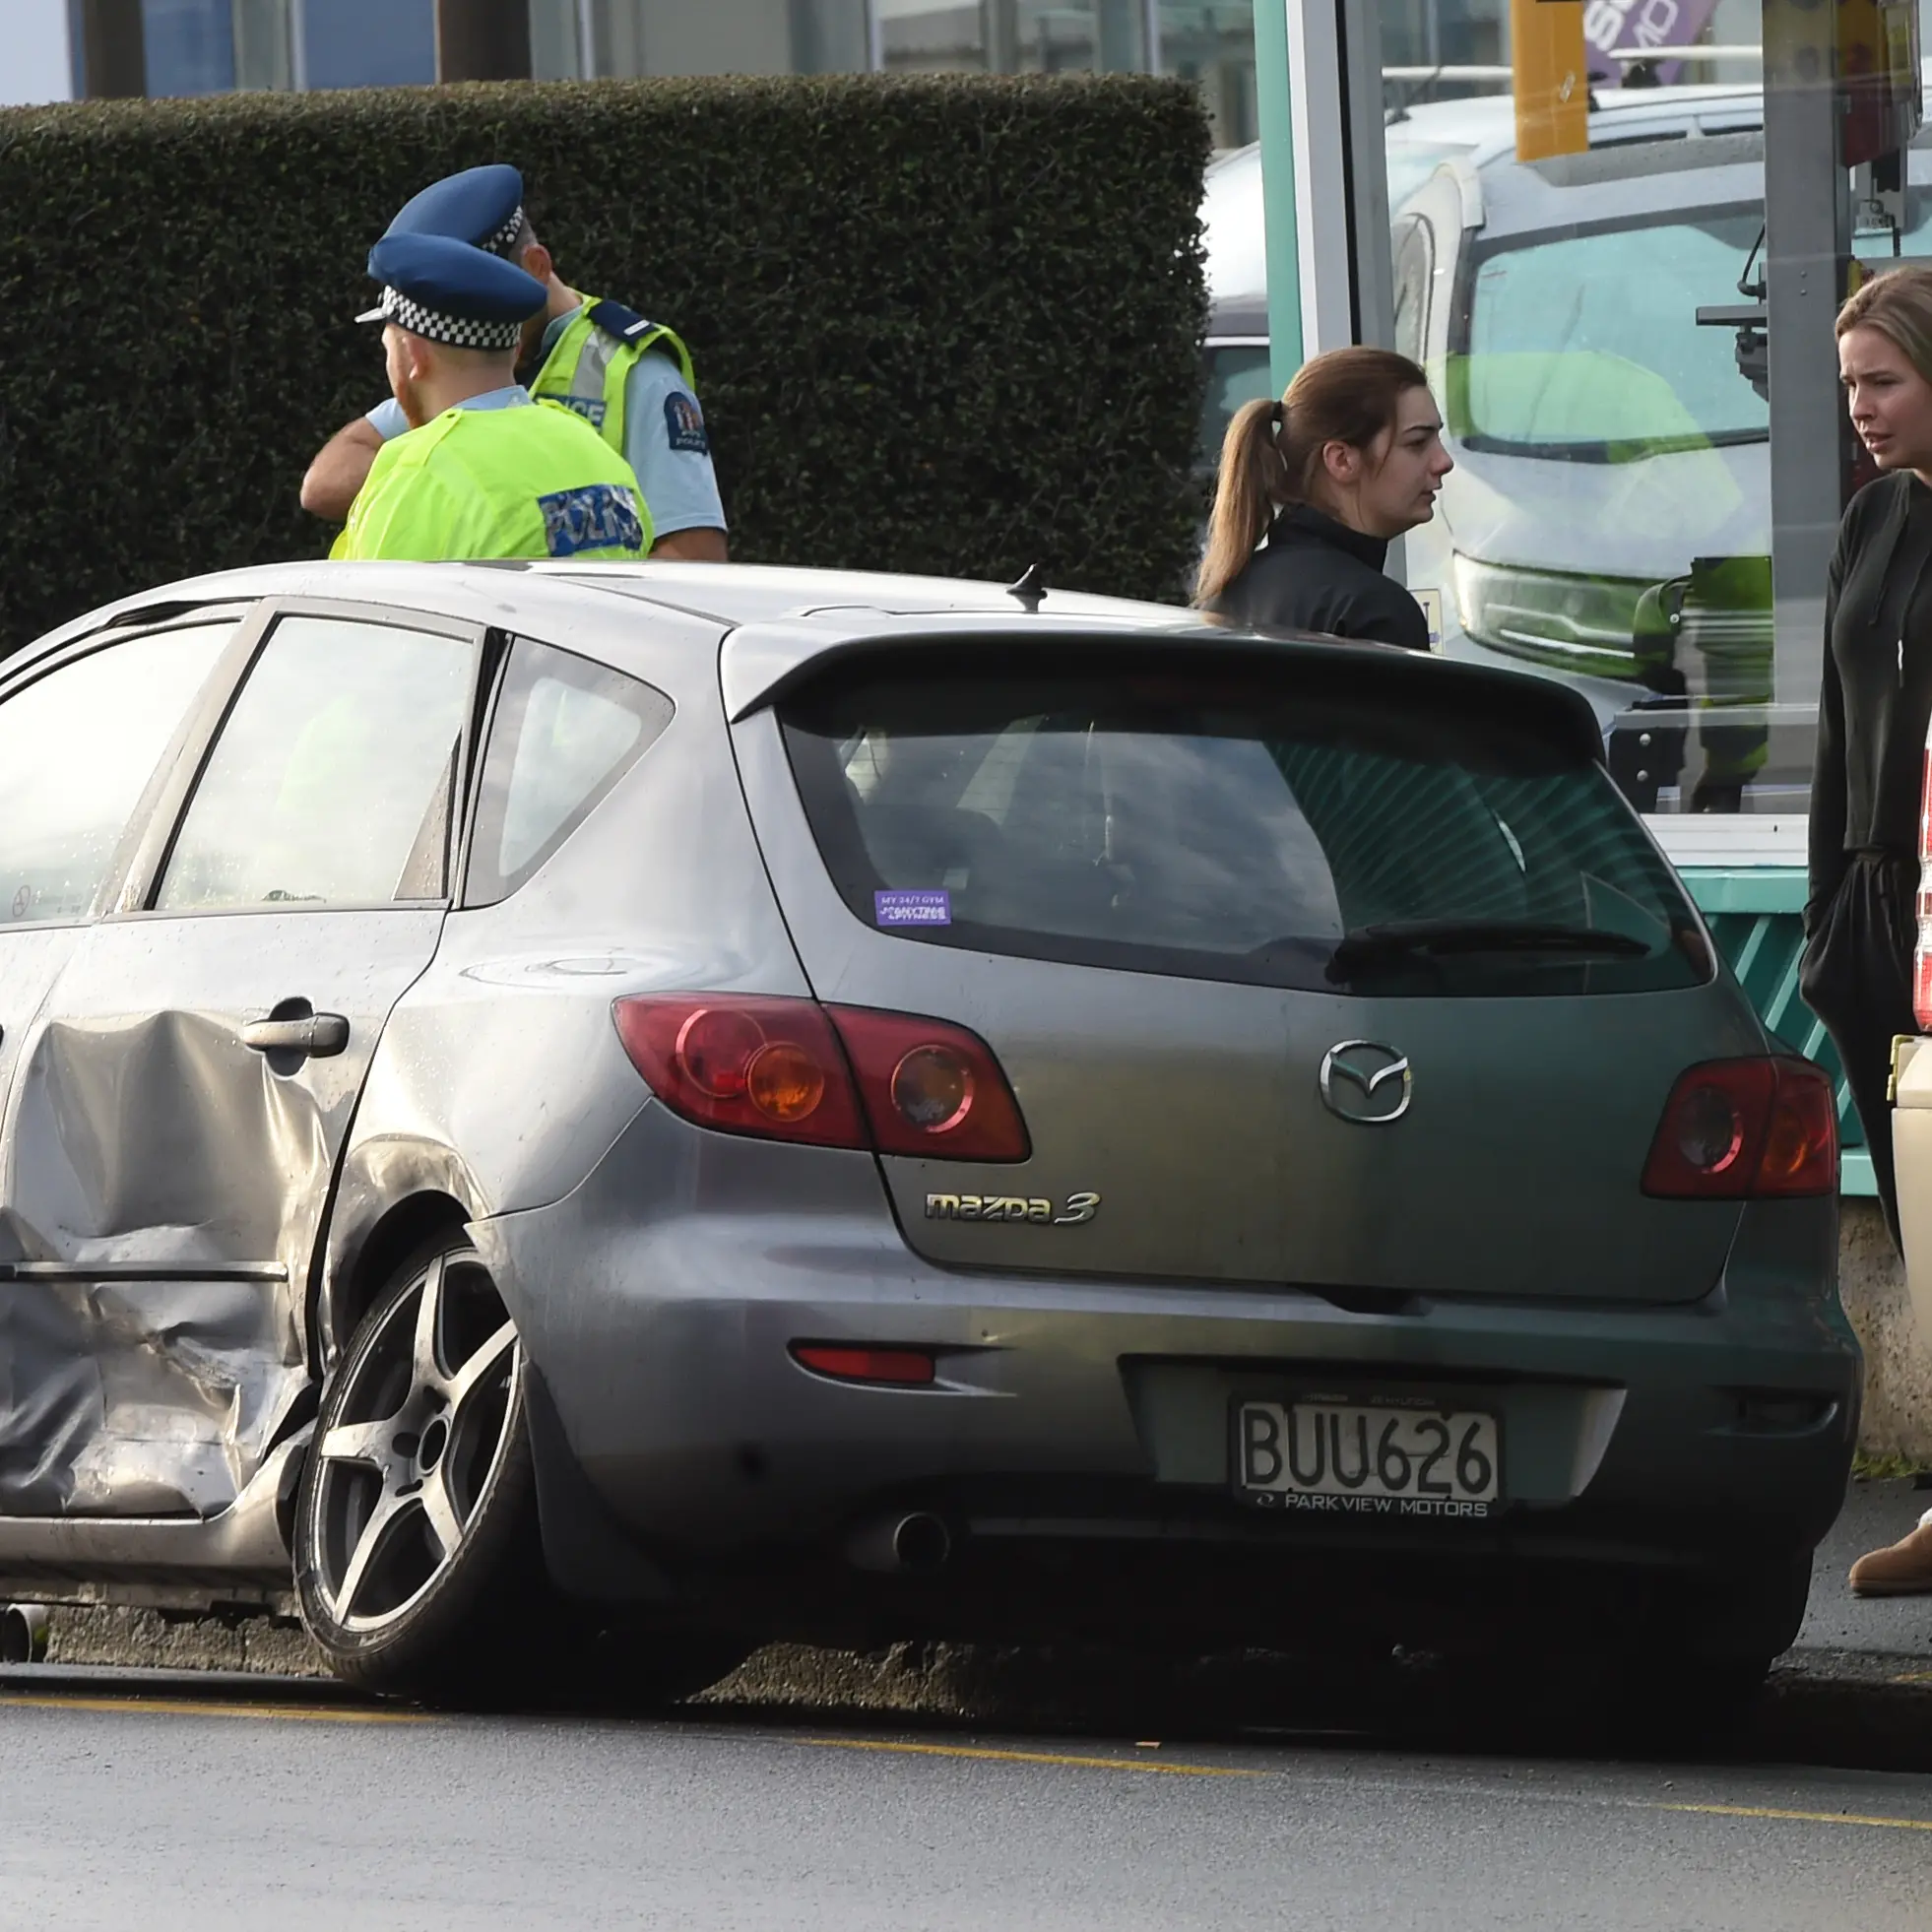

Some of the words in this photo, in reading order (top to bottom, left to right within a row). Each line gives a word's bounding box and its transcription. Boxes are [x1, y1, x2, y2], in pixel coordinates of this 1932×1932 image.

[1054, 1191, 1102, 1225] 3
[1244, 1408, 1492, 1495] BUU626
[1285, 1494, 1338, 1511] PARK
[1341, 1497, 1392, 1513] VIEW
[1400, 1500, 1488, 1517] MOTORS
